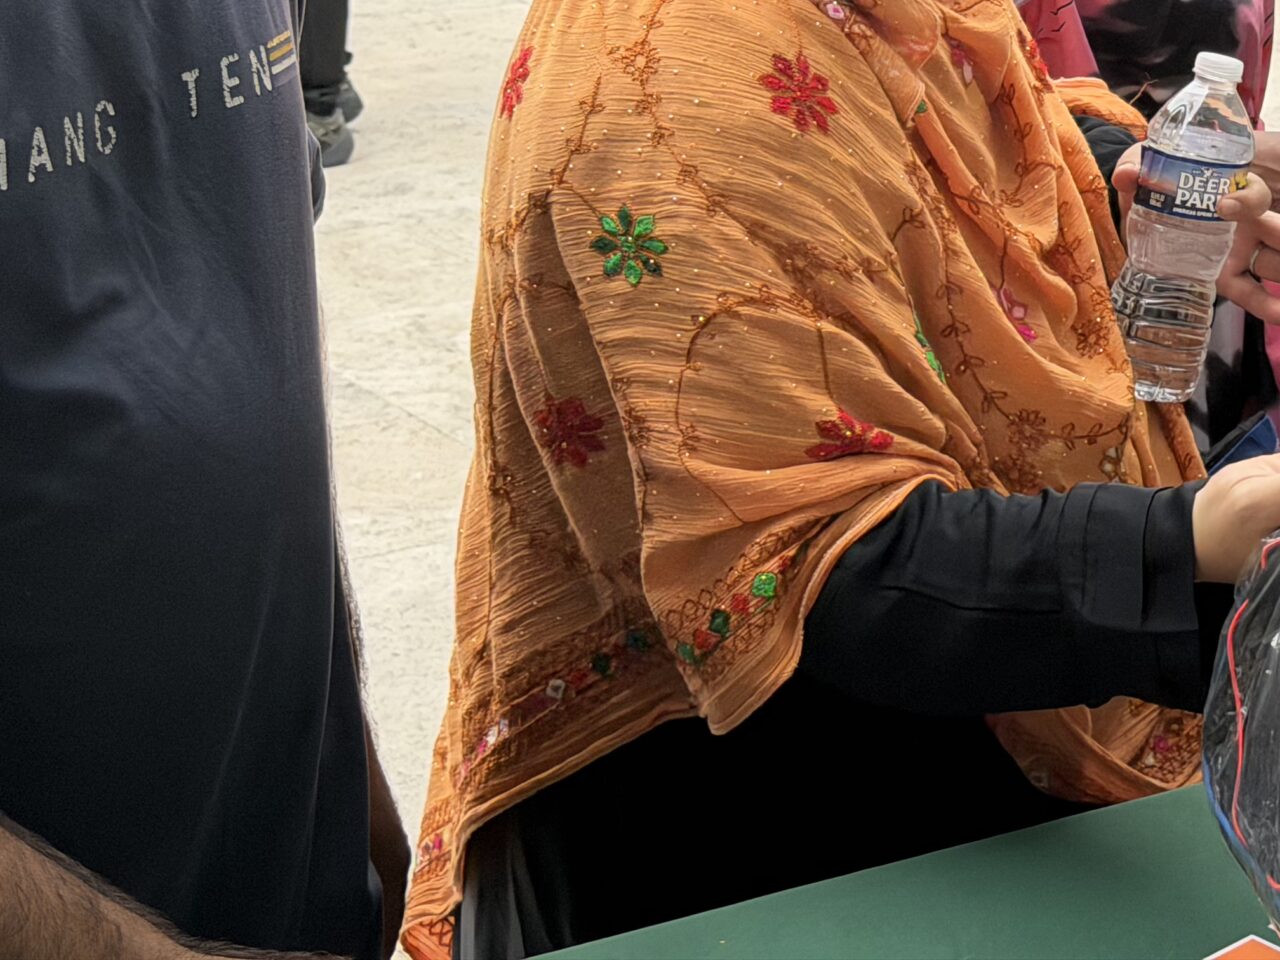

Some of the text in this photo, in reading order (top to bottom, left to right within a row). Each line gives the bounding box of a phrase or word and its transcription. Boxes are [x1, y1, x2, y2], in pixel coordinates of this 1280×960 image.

[0, 44, 273, 191] ANG TEN
[1179, 172, 1230, 194] DEER
[1175, 189, 1219, 212] PAR
